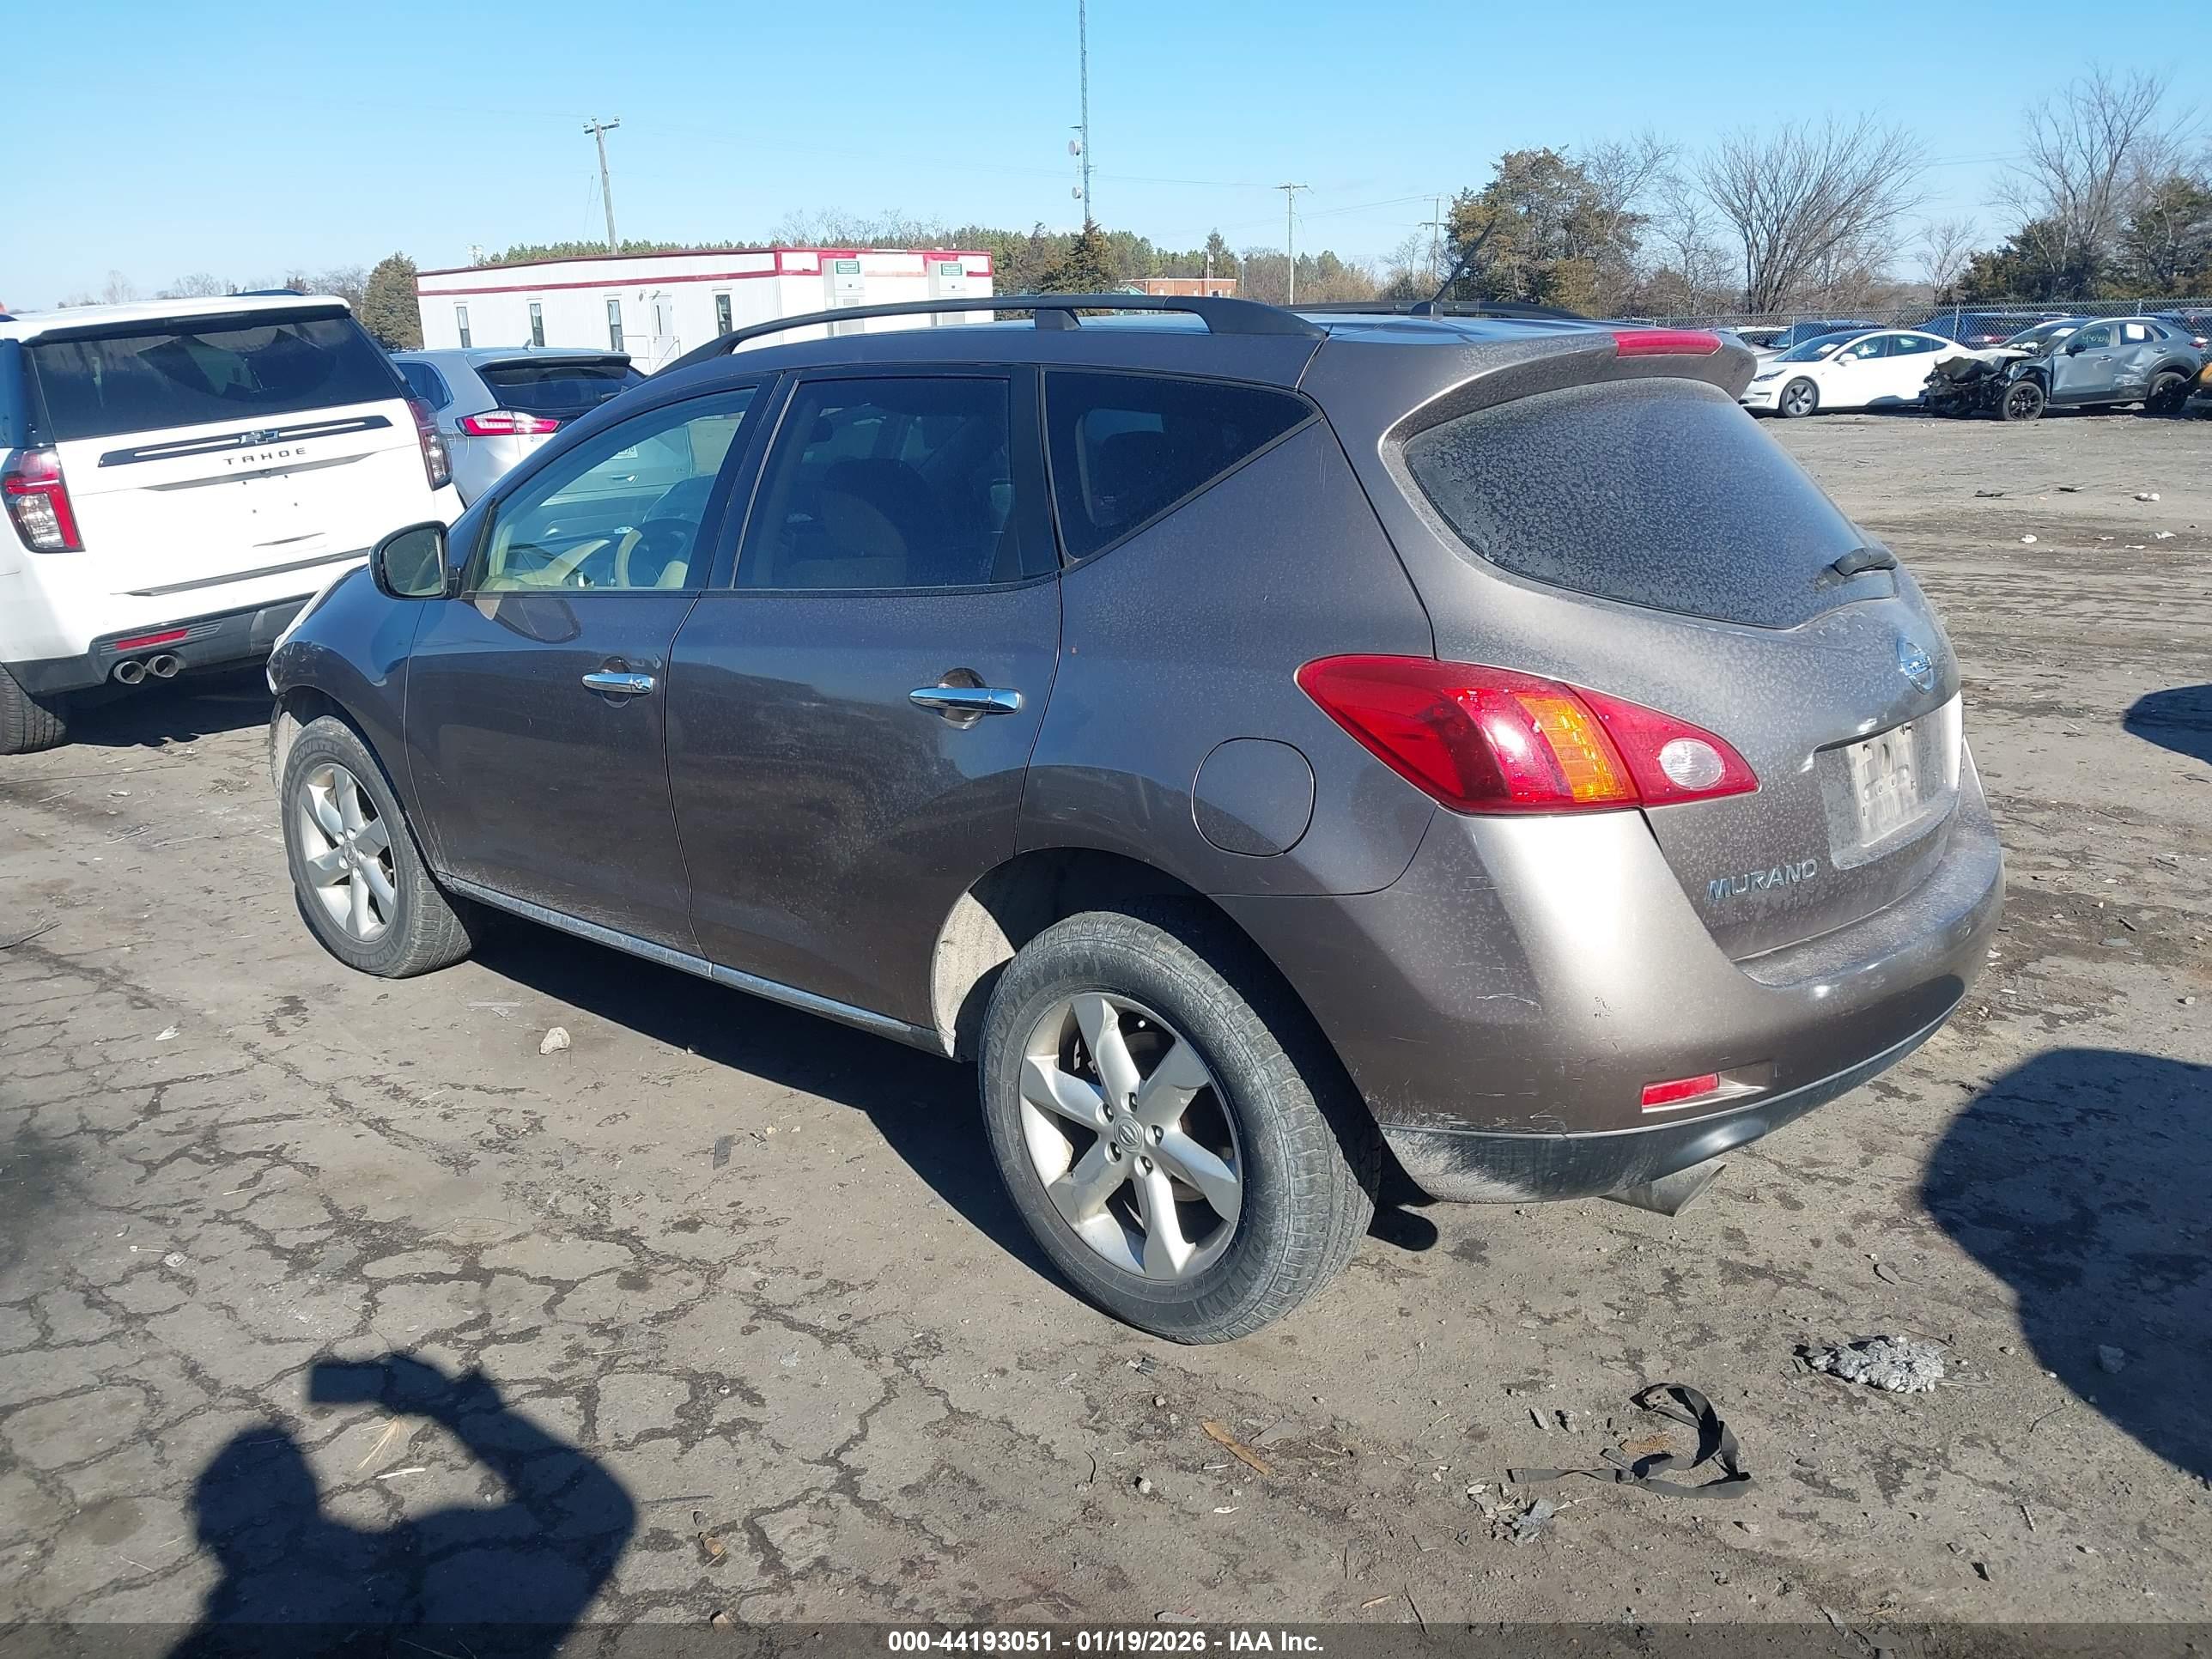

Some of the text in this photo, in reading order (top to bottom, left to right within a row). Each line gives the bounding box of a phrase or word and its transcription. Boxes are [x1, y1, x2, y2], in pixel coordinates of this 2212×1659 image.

[223, 447, 307, 465] TAHOE
[294, 741, 340, 765] COUNTRY
[1705, 859, 1818, 902] MURANO
